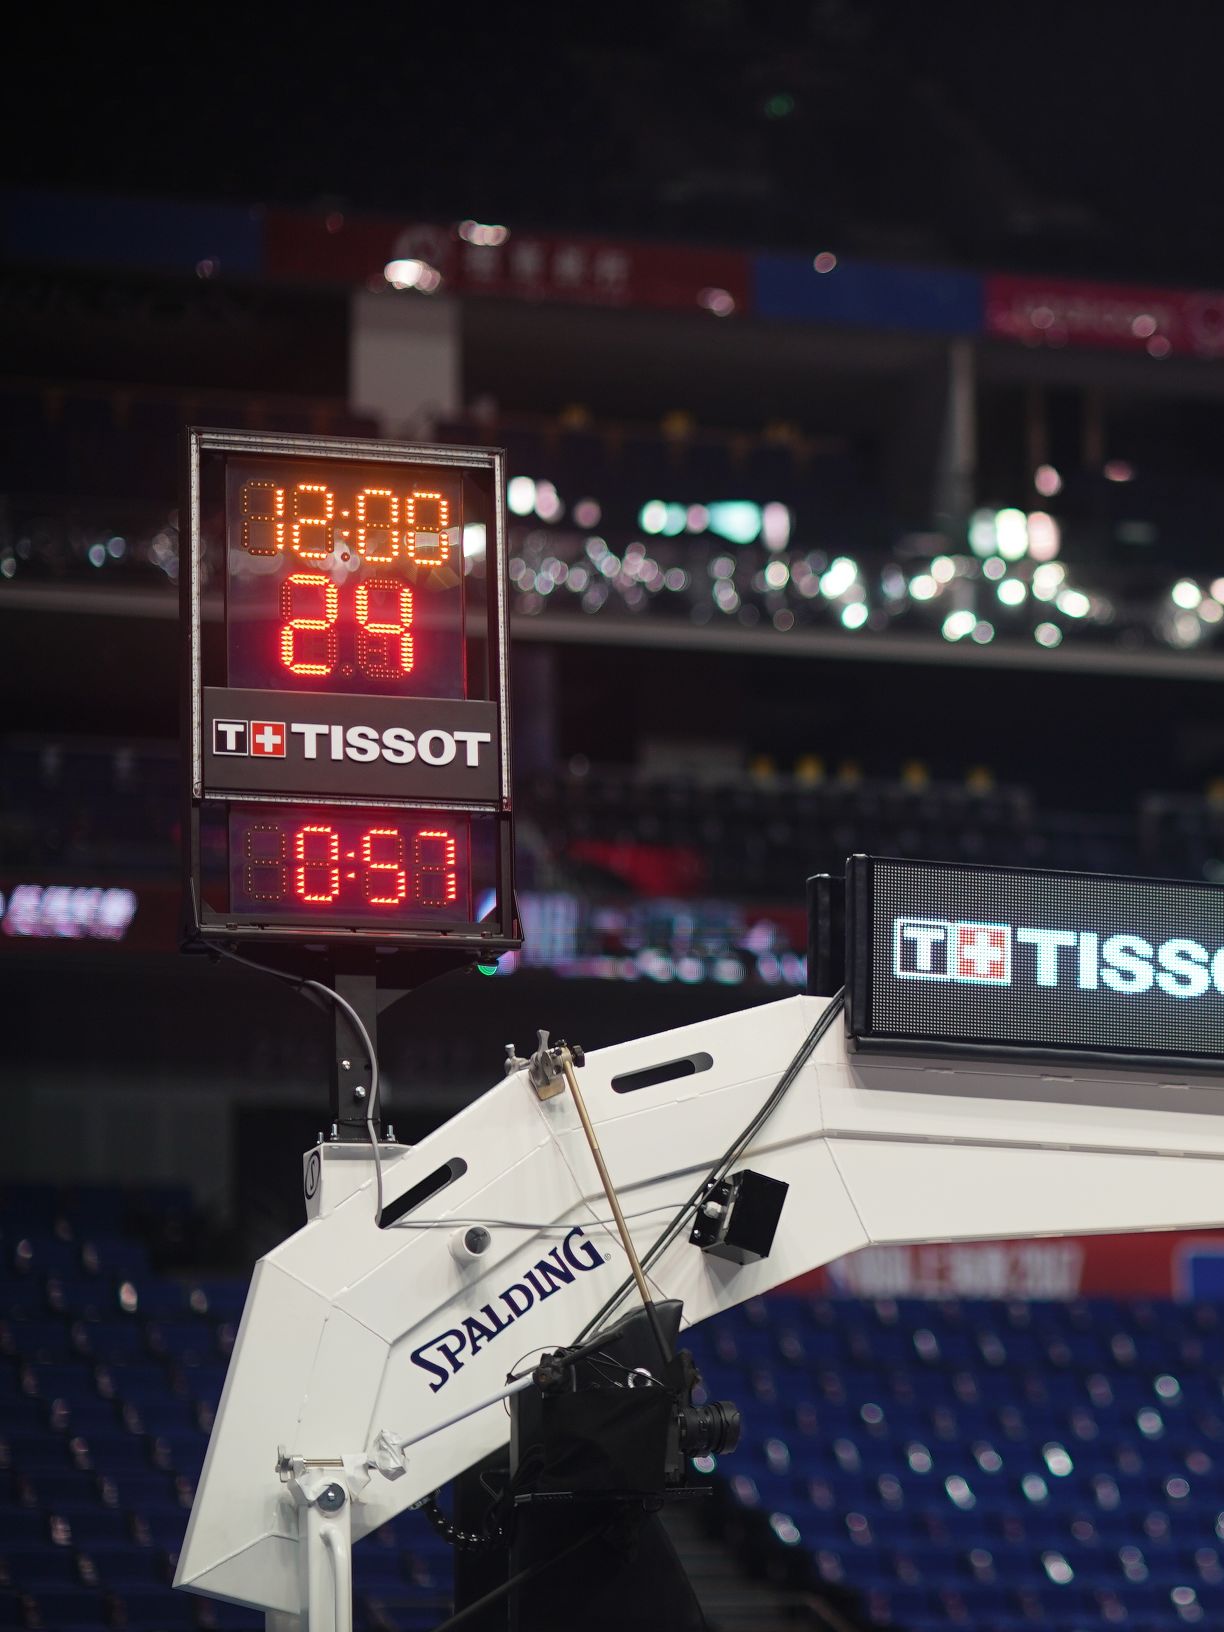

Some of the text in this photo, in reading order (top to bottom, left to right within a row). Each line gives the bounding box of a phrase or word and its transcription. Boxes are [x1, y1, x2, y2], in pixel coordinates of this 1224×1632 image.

[274, 483, 449, 567] 12:00
[281, 573, 414, 677] 24
[291, 723, 491, 767] TISSOT
[297, 825, 457, 904] 0:57
[410, 1225, 606, 1393] SPALDING
